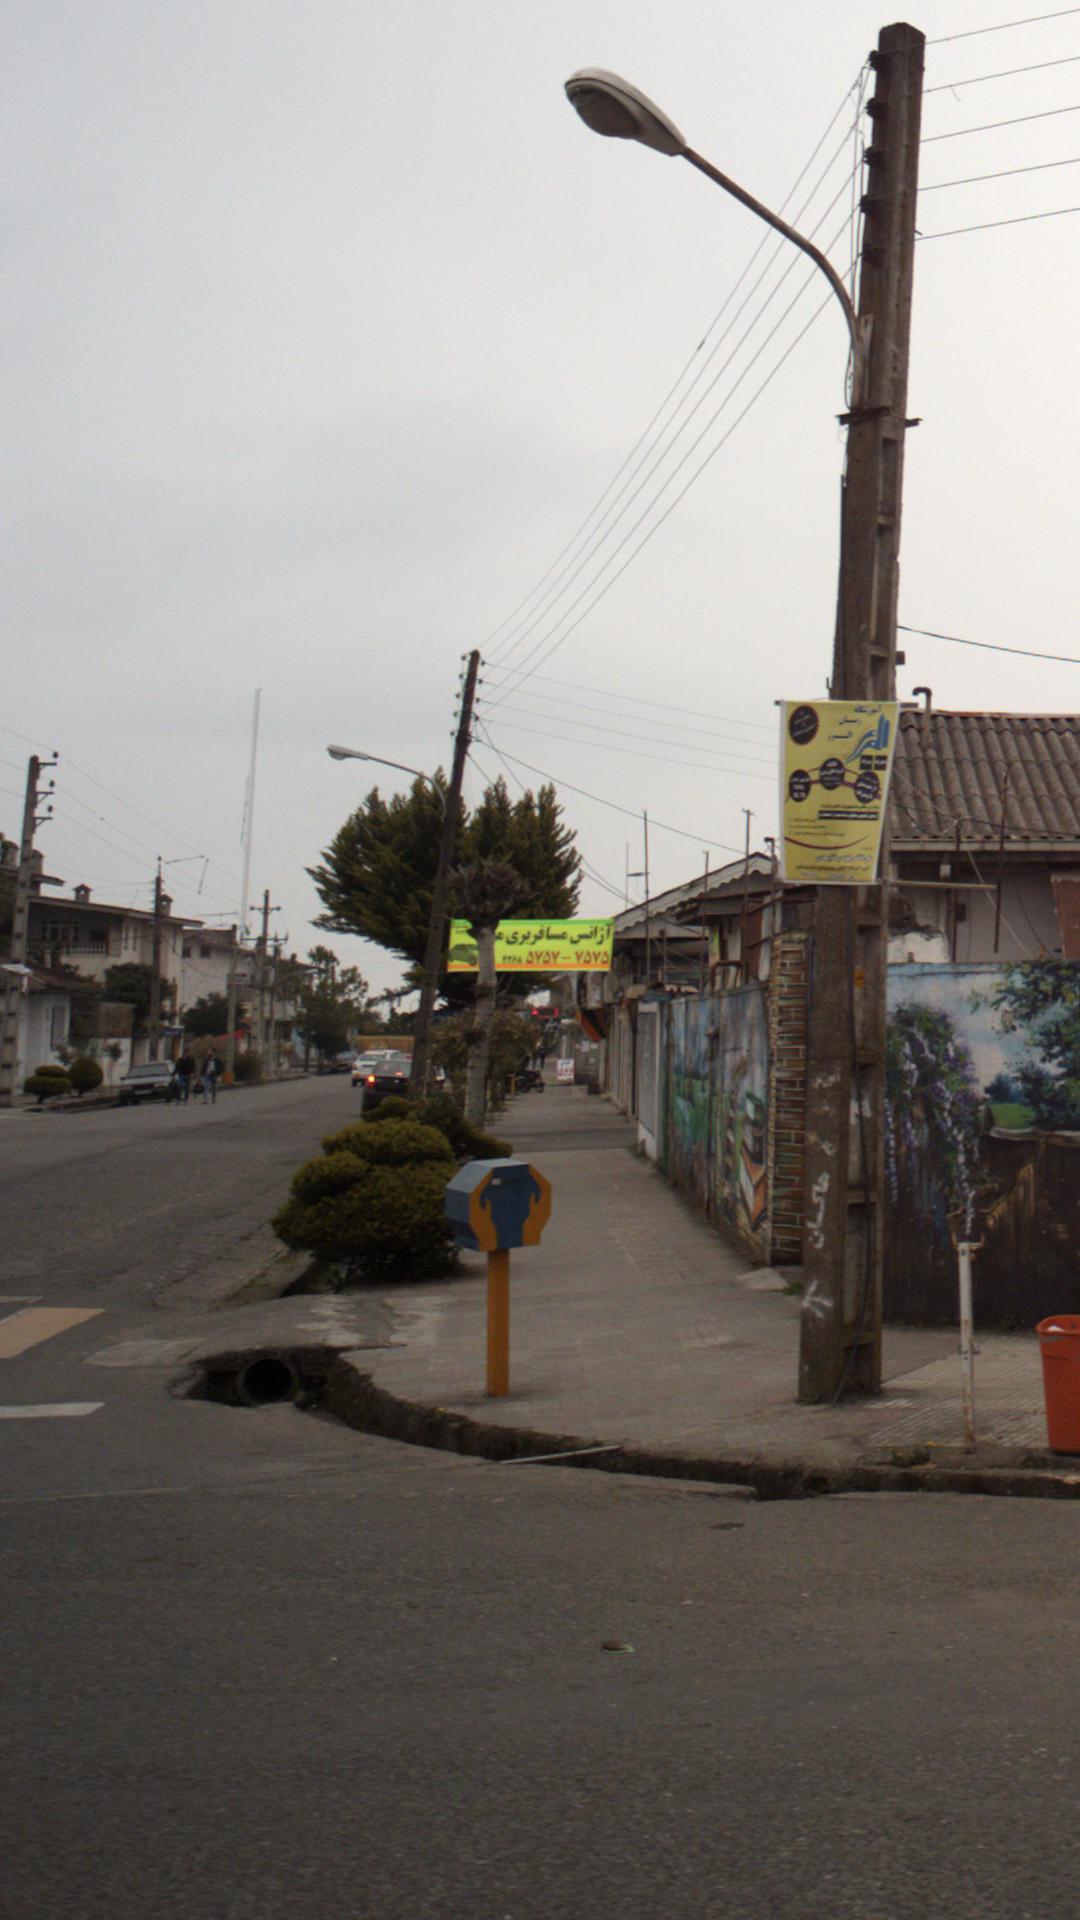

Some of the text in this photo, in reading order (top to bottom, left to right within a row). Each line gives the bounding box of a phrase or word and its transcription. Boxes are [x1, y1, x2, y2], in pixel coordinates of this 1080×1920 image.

[505, 924, 568, 945] مسافربری
[569, 923, 613, 945] آژانس
[525, 950, 560, 965] ۵۷۵۷
[575, 950, 610, 965] ۷۵۷۵
